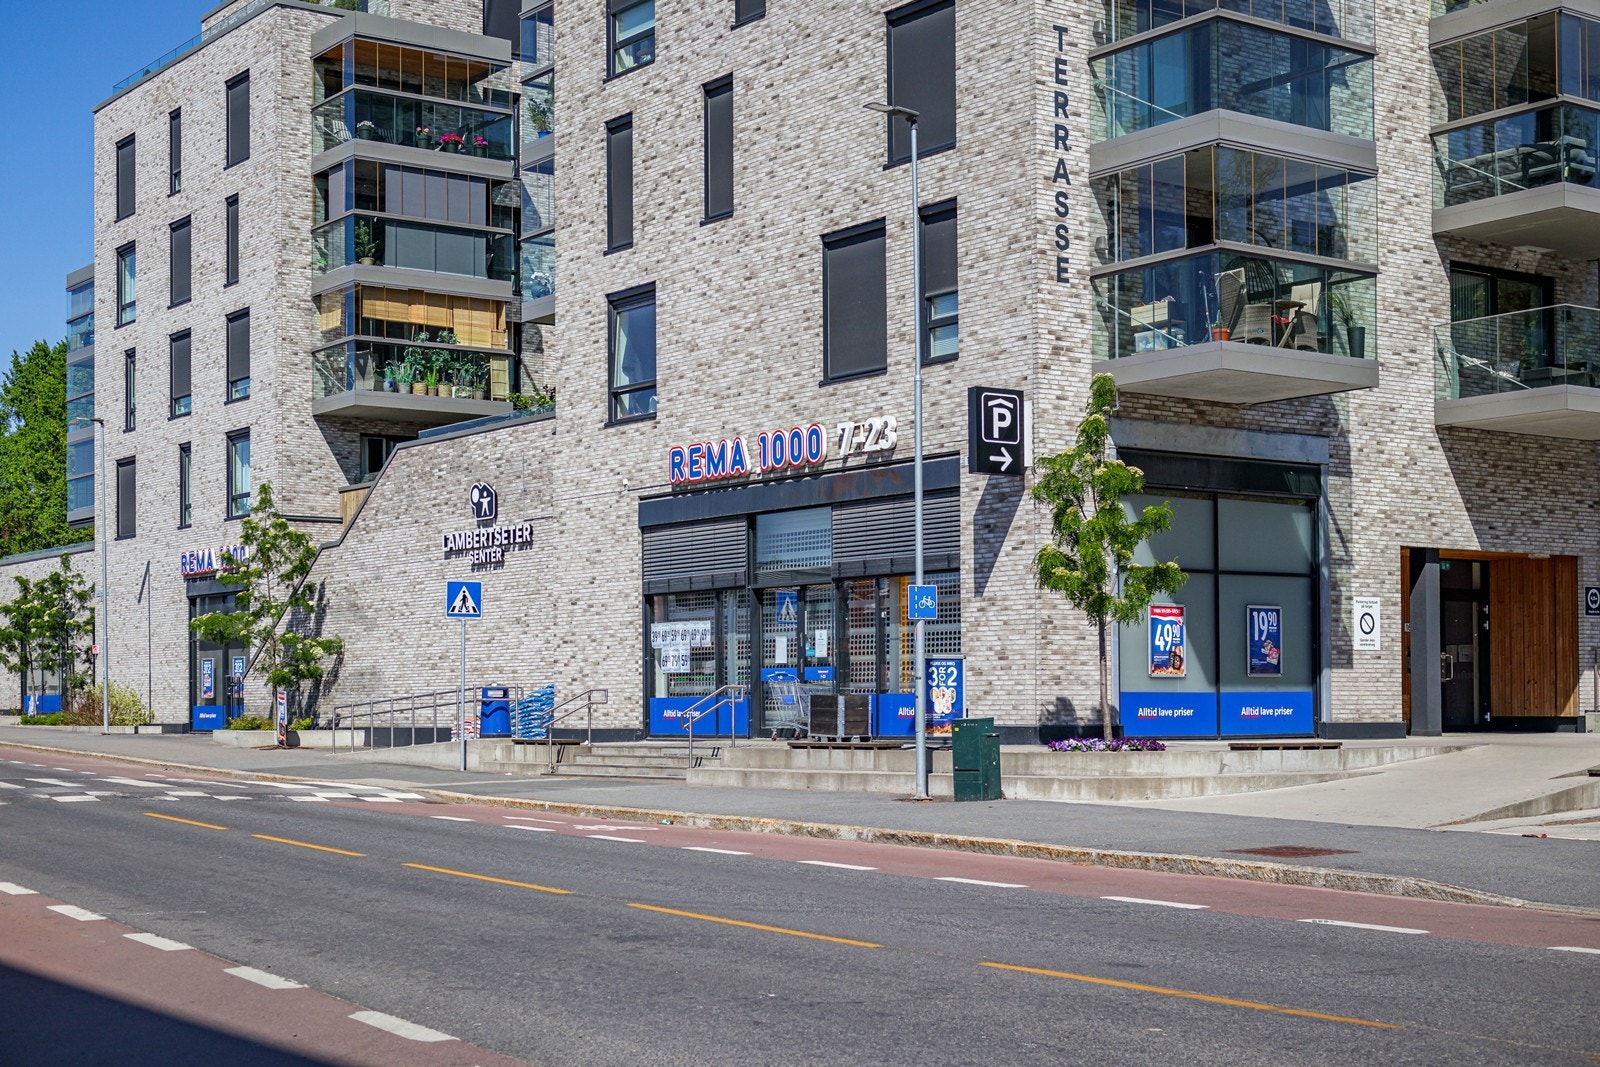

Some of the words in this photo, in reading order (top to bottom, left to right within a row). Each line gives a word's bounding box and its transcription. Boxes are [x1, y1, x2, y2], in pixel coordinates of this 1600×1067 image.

[1052, 24, 1072, 284] TERRASSE
[669, 436, 748, 484] REMA
[757, 423, 826, 472] 1000
[837, 415, 897, 456] 7-23
[443, 523, 532, 552] LAMBERTSETER
[180, 548, 214, 577] REMA
[469, 547, 503, 564] SENTER
[928, 666, 938, 687] 3
[947, 666, 957, 687] 2
[663, 709, 676, 718] Alltid
[898, 706, 915, 716] Alltid
[1137, 707, 1158, 717] Alltid
[1158, 707, 1173, 717] lave
[1174, 707, 1194, 718] priser
[1241, 706, 1259, 716] Alltid
[1260, 706, 1274, 716] lave
[1274, 706, 1293, 717] priser
